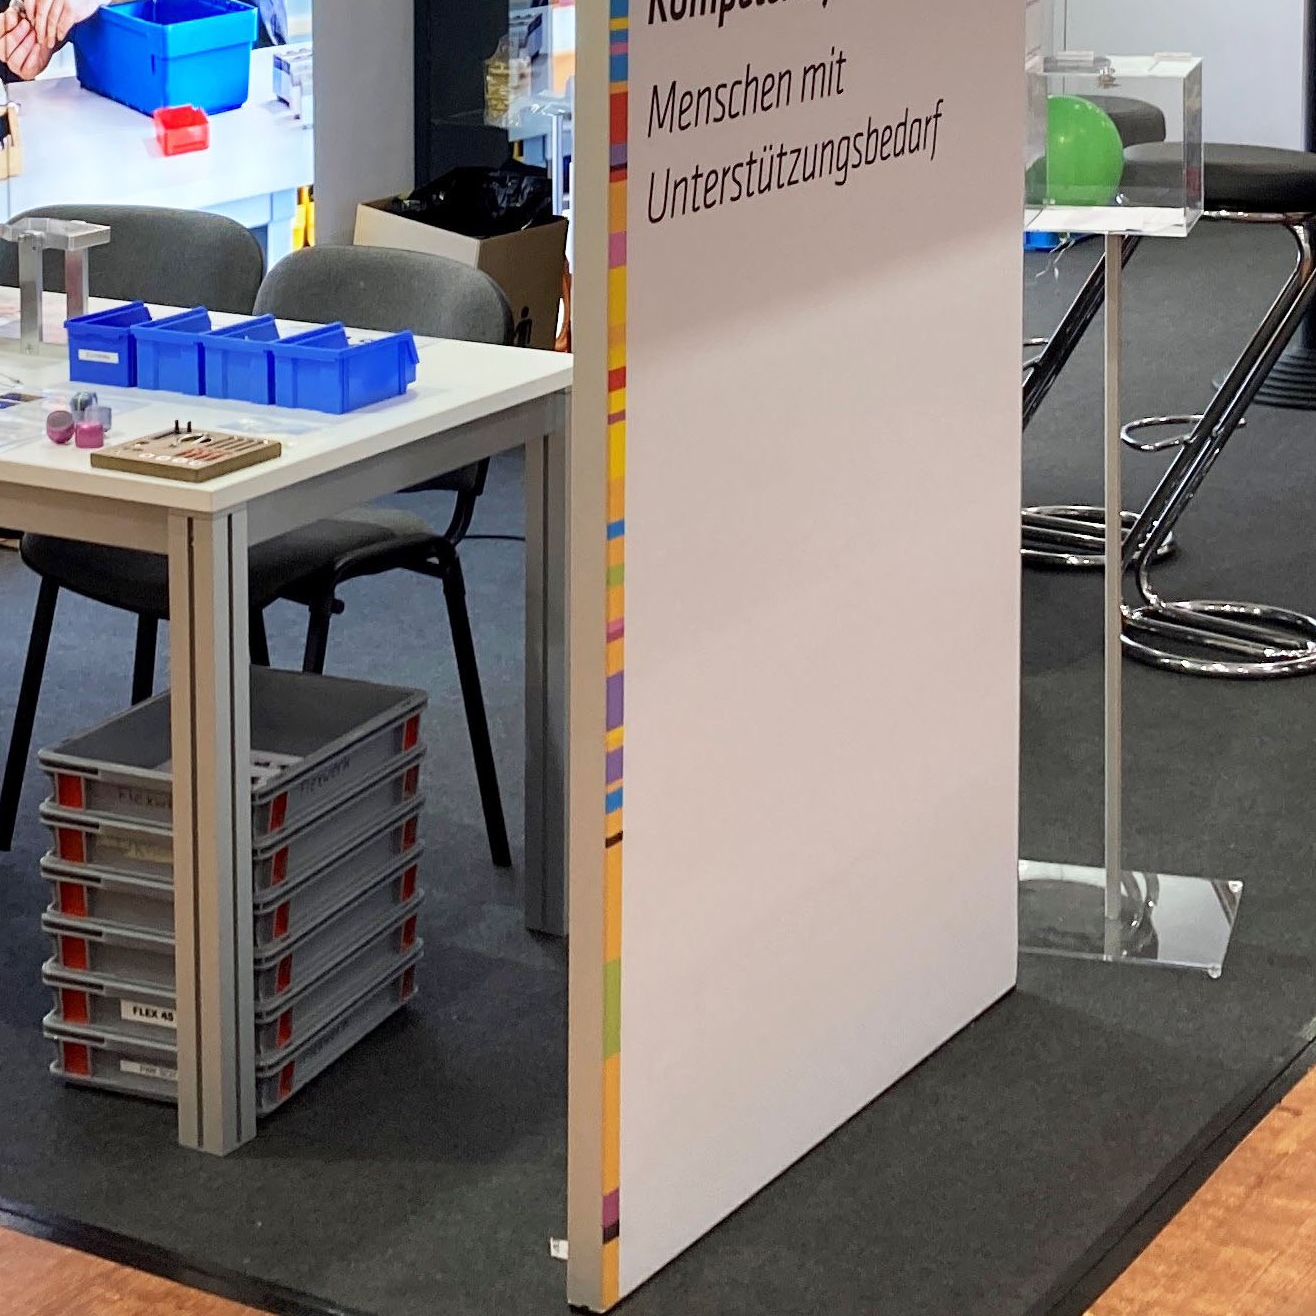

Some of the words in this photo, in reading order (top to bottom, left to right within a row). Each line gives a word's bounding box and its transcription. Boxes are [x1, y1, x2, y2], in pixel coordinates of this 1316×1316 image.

[648, 63, 792, 138] Menschen
[800, 46, 846, 103] mit
[648, 99, 944, 224] Unterstützungsbedarf
[132, 1005, 159, 1020] FLEX
